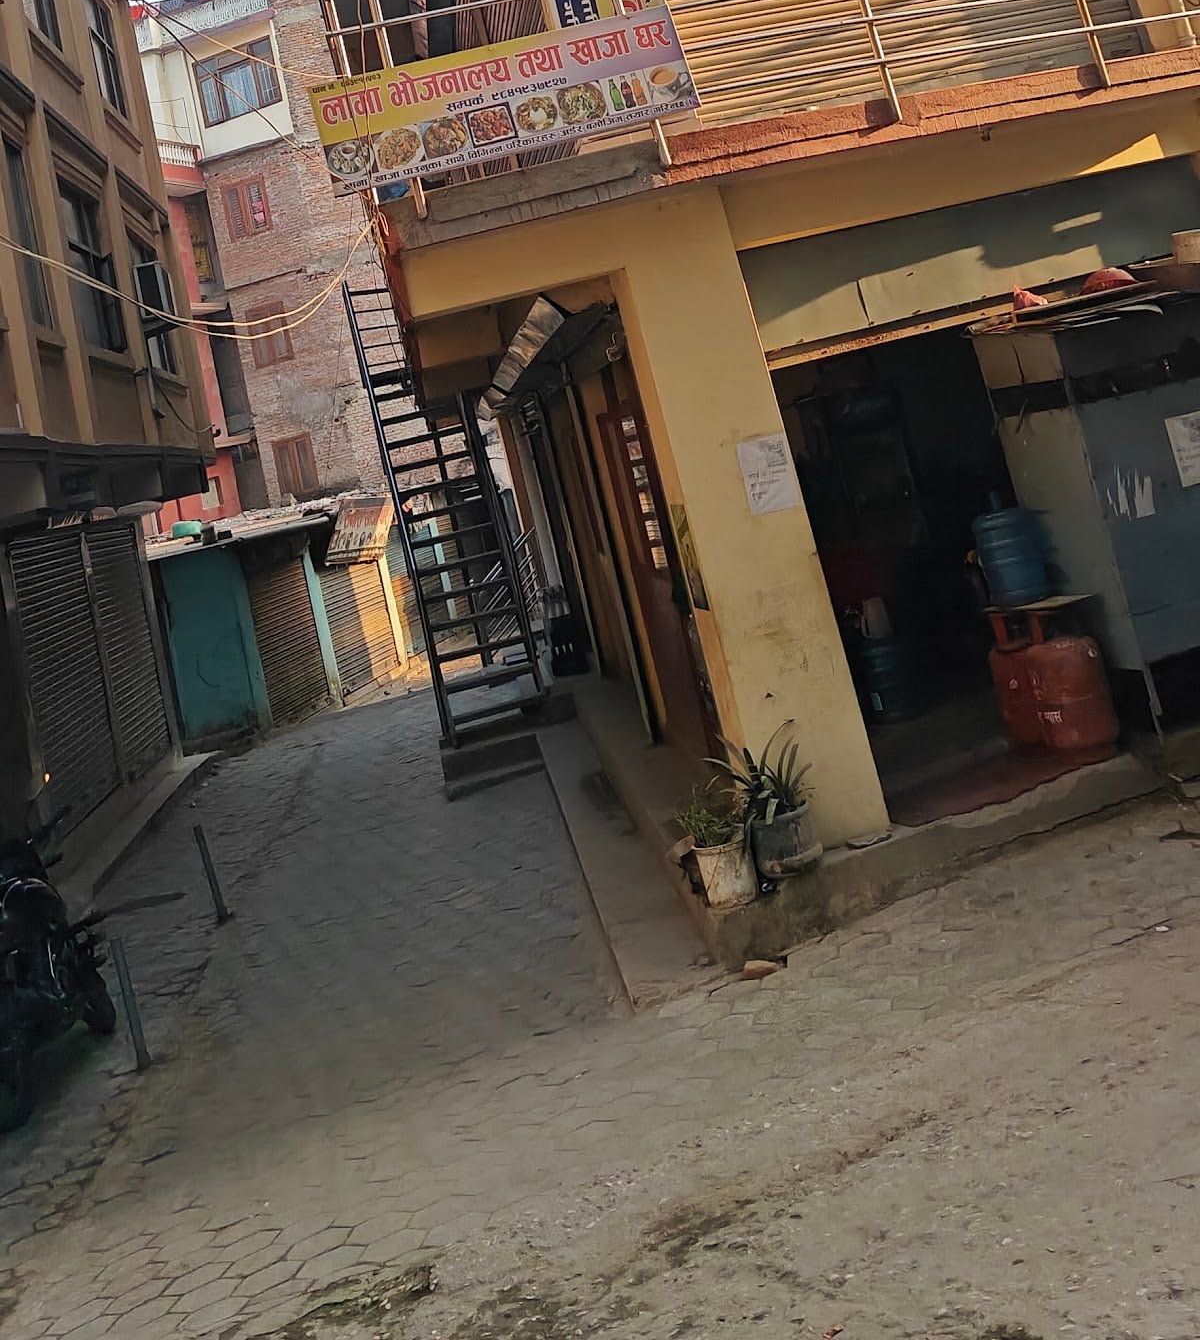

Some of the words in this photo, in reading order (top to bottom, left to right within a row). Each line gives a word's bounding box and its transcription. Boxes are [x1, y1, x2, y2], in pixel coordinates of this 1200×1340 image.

[387, 57, 512, 107] भोजनालय
[514, 44, 562, 79] तथा
[567, 29, 631, 66] खाजा
[633, 20, 671, 50] घर
